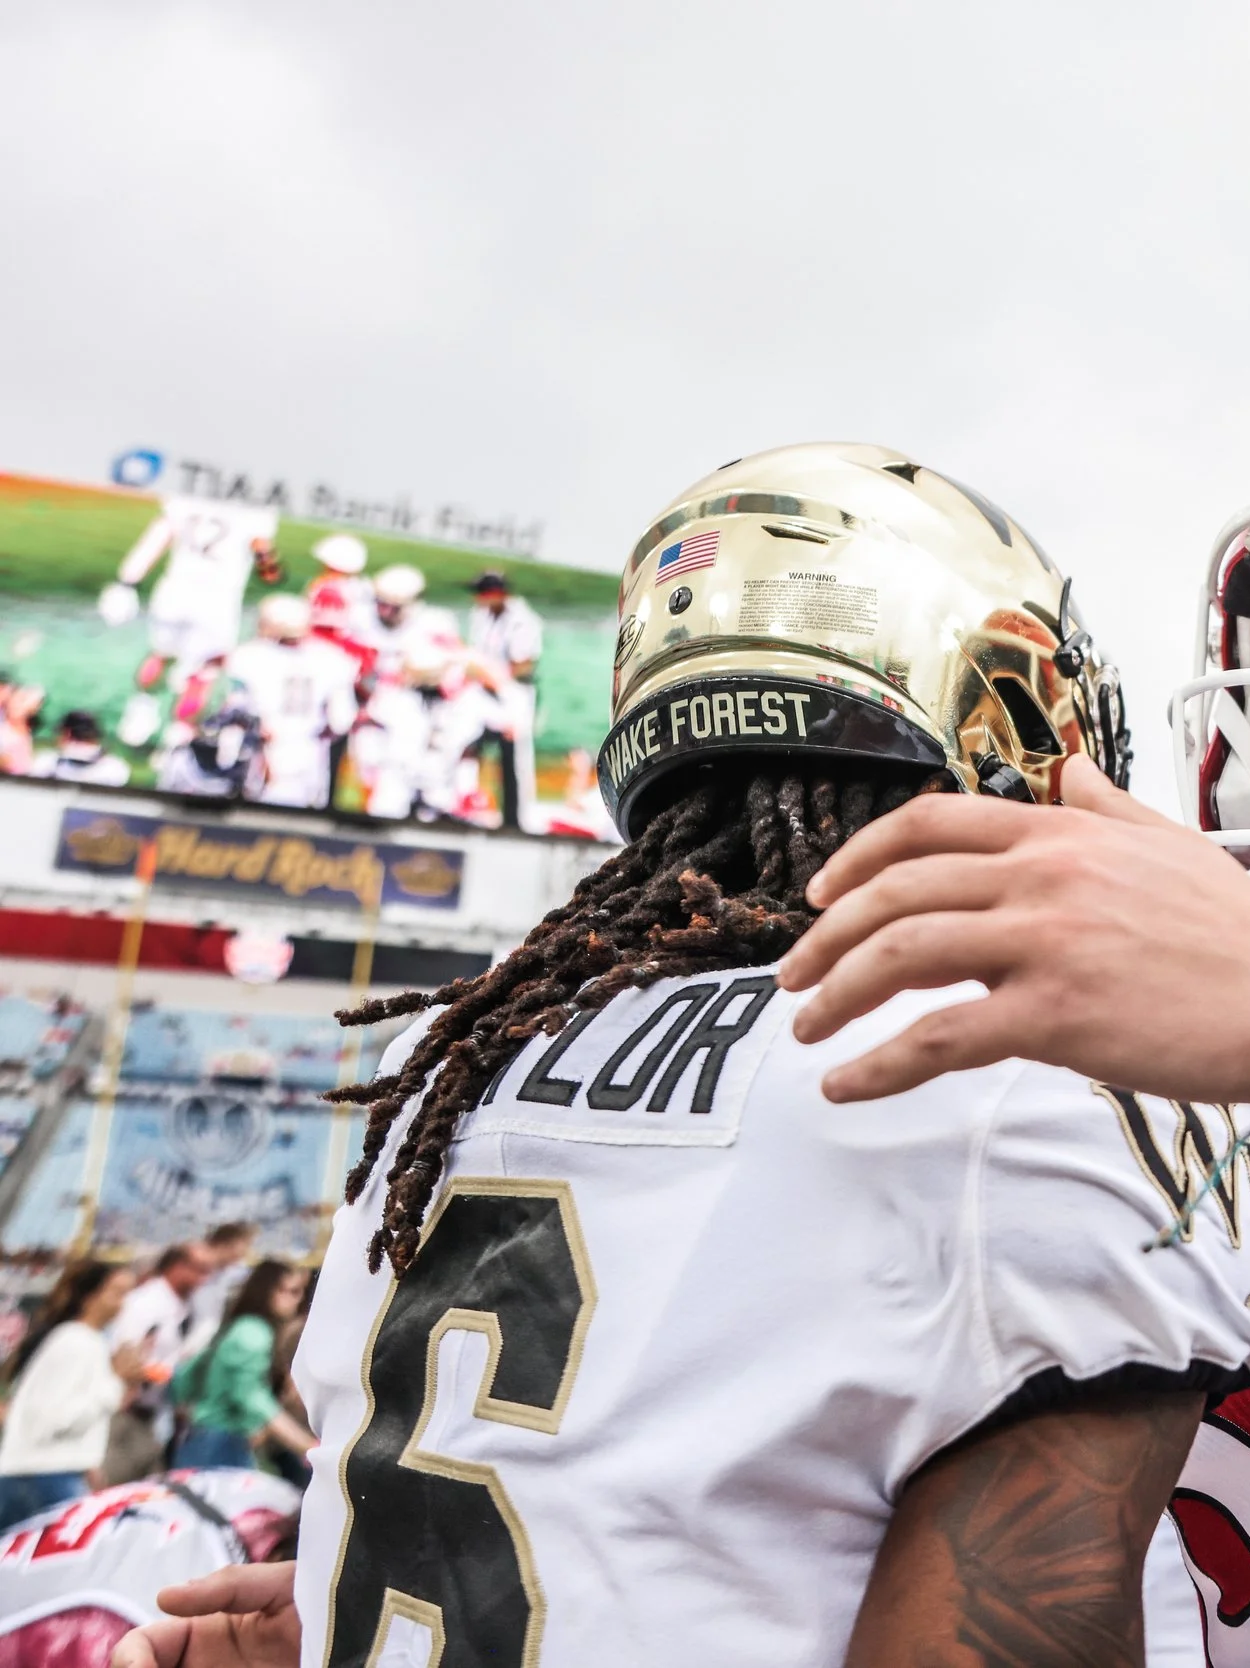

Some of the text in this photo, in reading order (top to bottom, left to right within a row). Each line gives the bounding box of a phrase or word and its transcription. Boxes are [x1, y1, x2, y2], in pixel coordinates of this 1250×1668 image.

[789, 572, 837, 583] WARNING
[605, 691, 811, 789] WAKE FOREST
[153, 824, 384, 897] Hard Rock
[324, 1176, 598, 1668] 6
